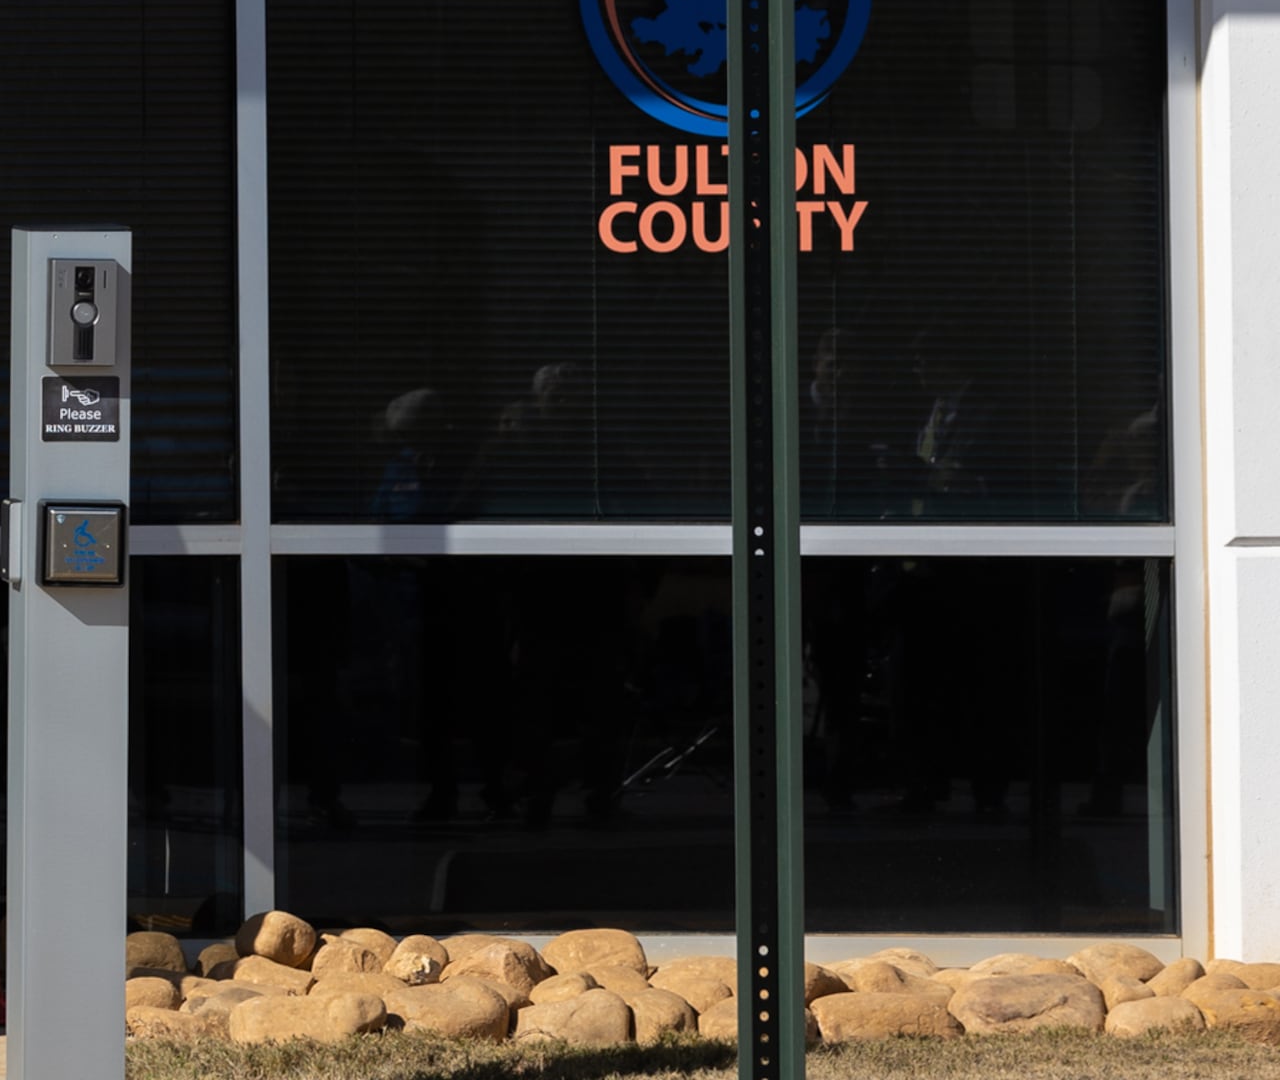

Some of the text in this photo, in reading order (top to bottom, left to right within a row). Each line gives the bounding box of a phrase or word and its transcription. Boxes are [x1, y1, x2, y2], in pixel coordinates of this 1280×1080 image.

[609, 144, 856, 196] FULN
[598, 200, 869, 253] COUTY
[45, 424, 116, 433] RING BUZZER
[60, 407, 102, 420] Please
